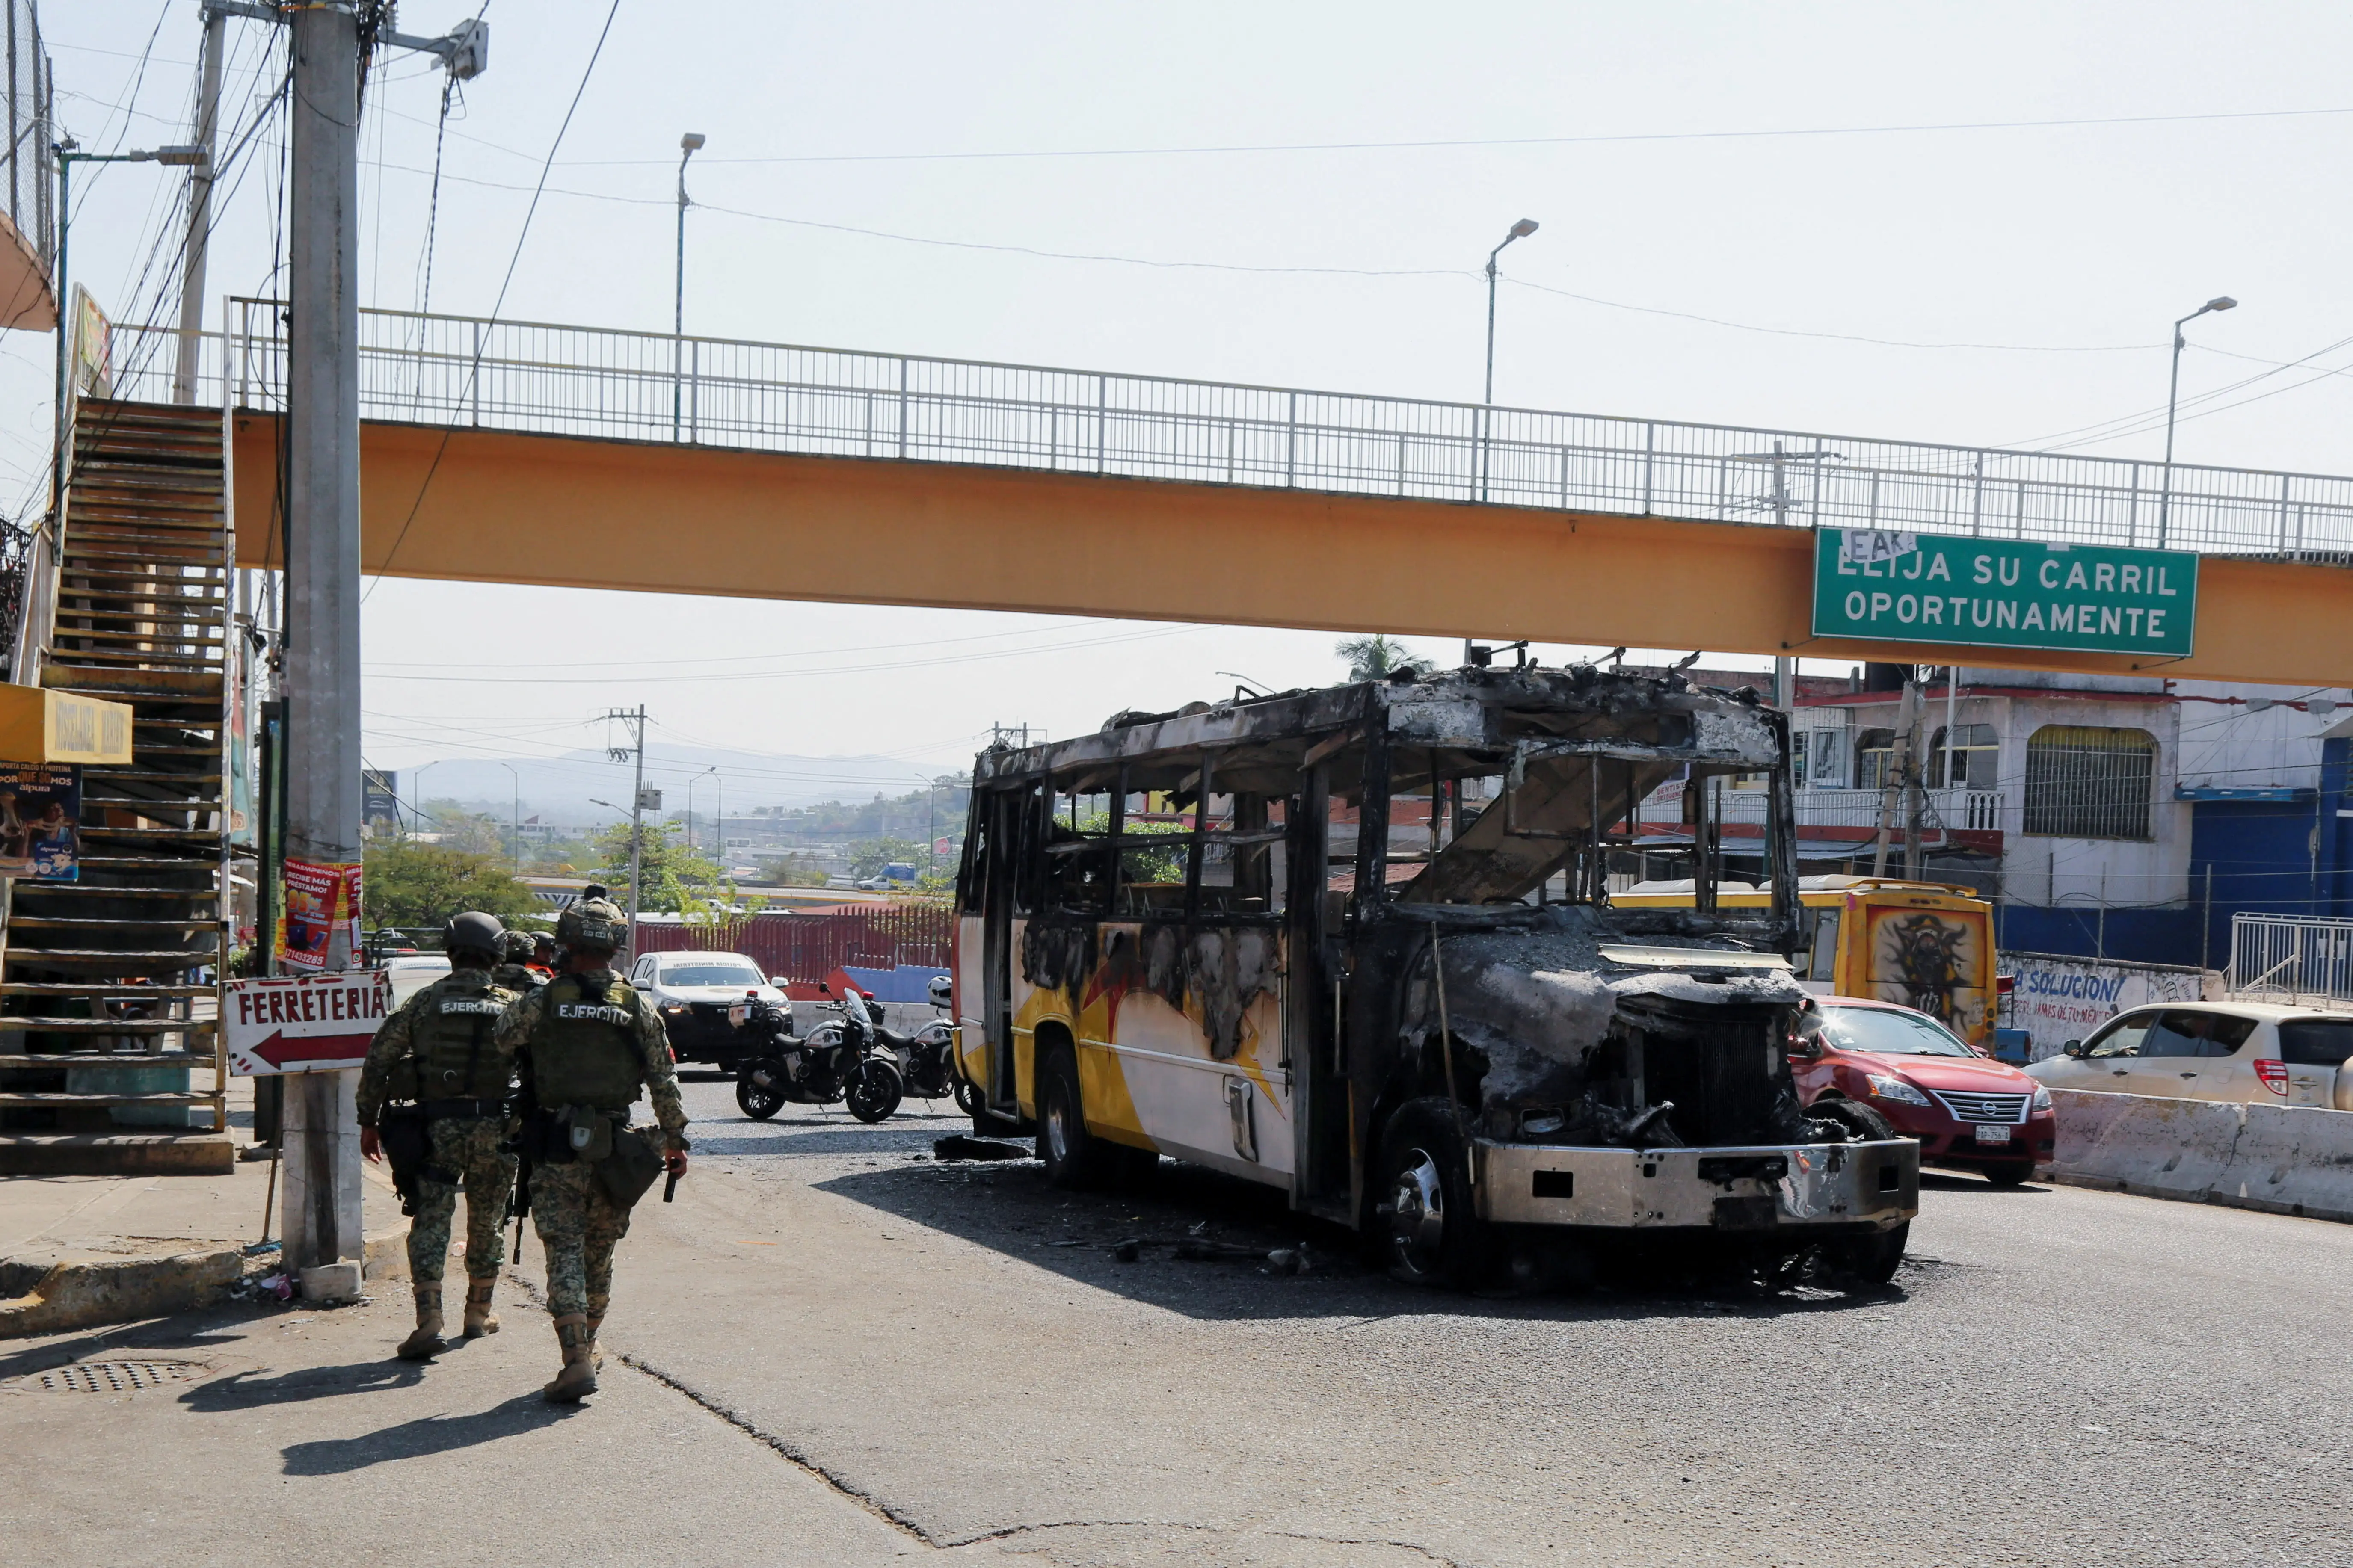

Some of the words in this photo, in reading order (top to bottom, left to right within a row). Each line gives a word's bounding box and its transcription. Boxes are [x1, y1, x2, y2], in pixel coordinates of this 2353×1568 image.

[1838, 546, 1951, 581] ELIJA
[1973, 555, 2020, 586] SU
[2039, 559, 2177, 596] CARRIL
[1845, 591, 2166, 637] OPORTUNAMENTE
[287, 879, 327, 894] PRÉSTAMO!
[312, 877, 332, 886] MÁS
[238, 986, 386, 1025] FERRETERIA
